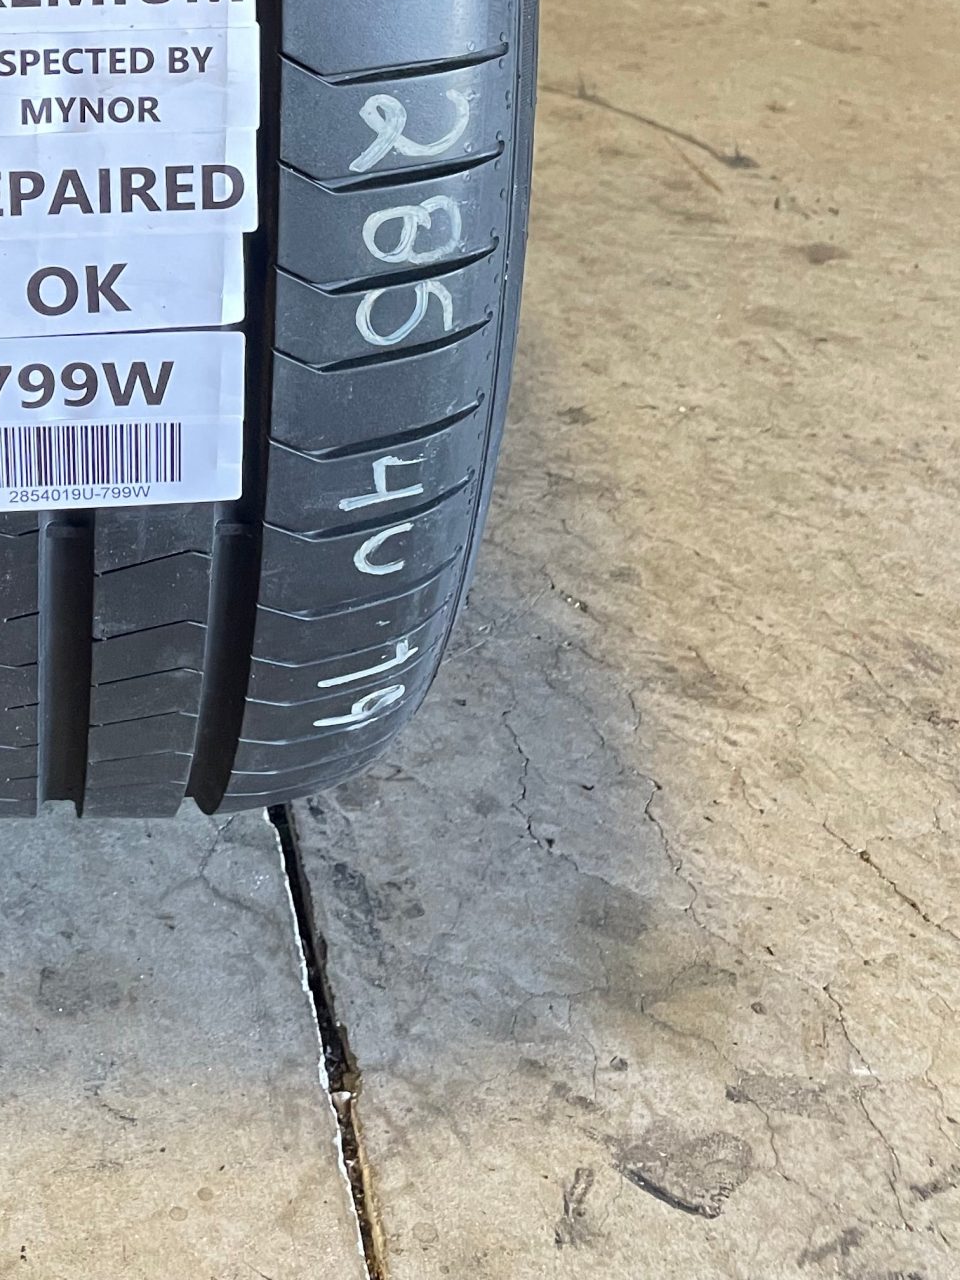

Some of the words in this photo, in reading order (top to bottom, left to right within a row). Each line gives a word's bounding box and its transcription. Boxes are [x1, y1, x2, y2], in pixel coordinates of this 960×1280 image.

[167, 46, 214, 74] BY
[20, 96, 162, 126] MYNOR
[347, 88, 470, 347] 285
[26, 262, 133, 317] OK
[8, 484, 152, 504] 2854019U-799W
